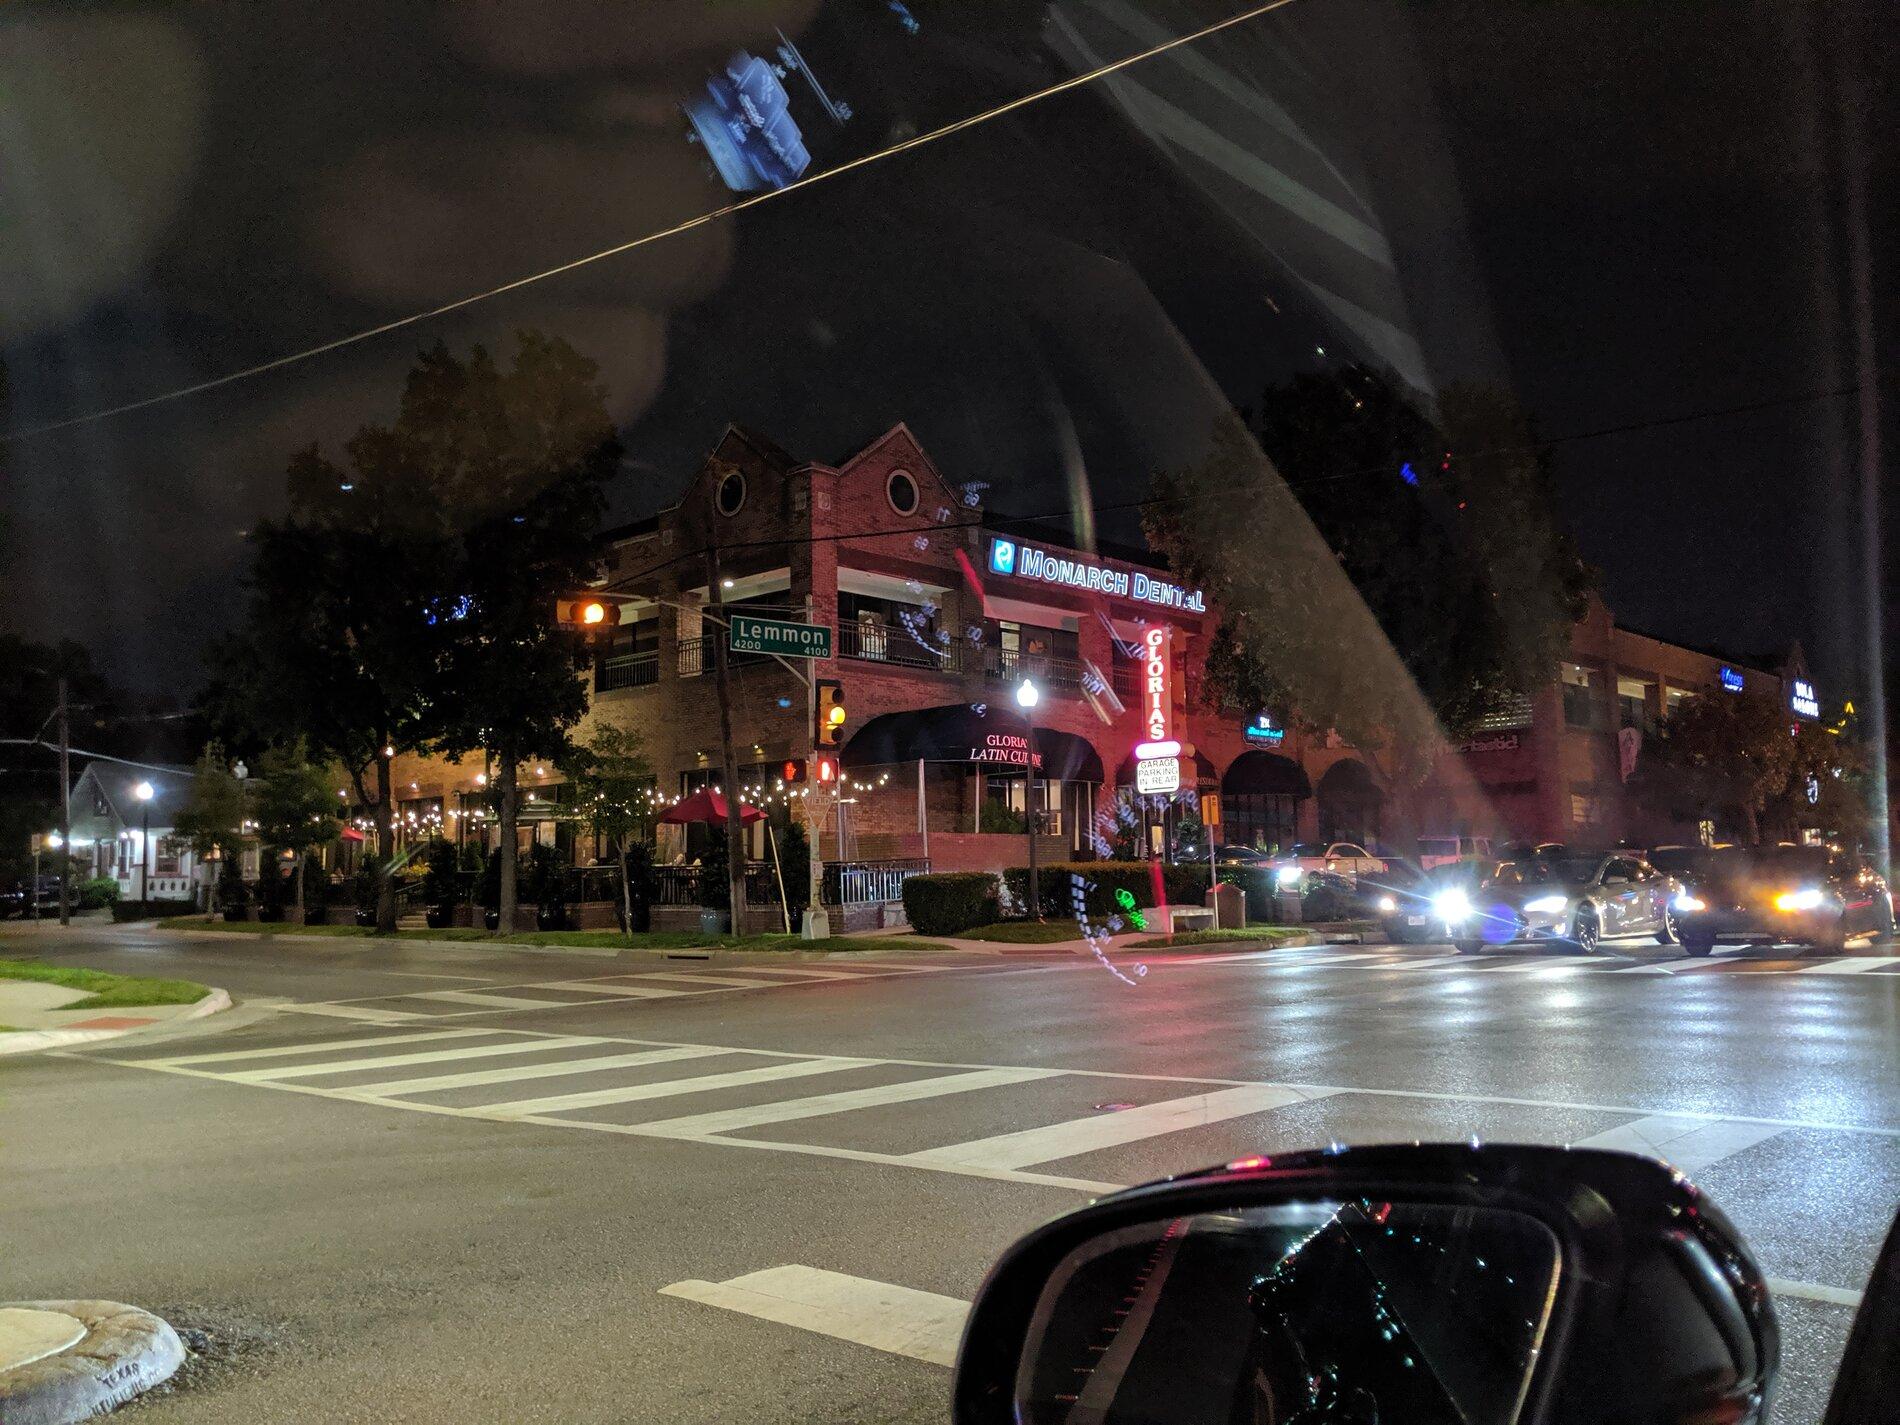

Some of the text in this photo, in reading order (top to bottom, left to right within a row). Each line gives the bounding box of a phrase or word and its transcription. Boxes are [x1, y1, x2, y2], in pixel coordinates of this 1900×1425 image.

[1020, 547, 1206, 612] MONARCH DENTAL
[740, 621, 824, 645] Lemmon
[734, 640, 828, 657] 4200 4100
[1146, 629, 1165, 740] GLORIAS
[987, 735, 1028, 748] GLORIA'
[970, 748, 1042, 766] LATIN CUIINE
[1140, 758, 1175, 769] GARAGE
[1139, 767, 1178, 777] PARKING
[1152, 776, 1177, 784] REAR
